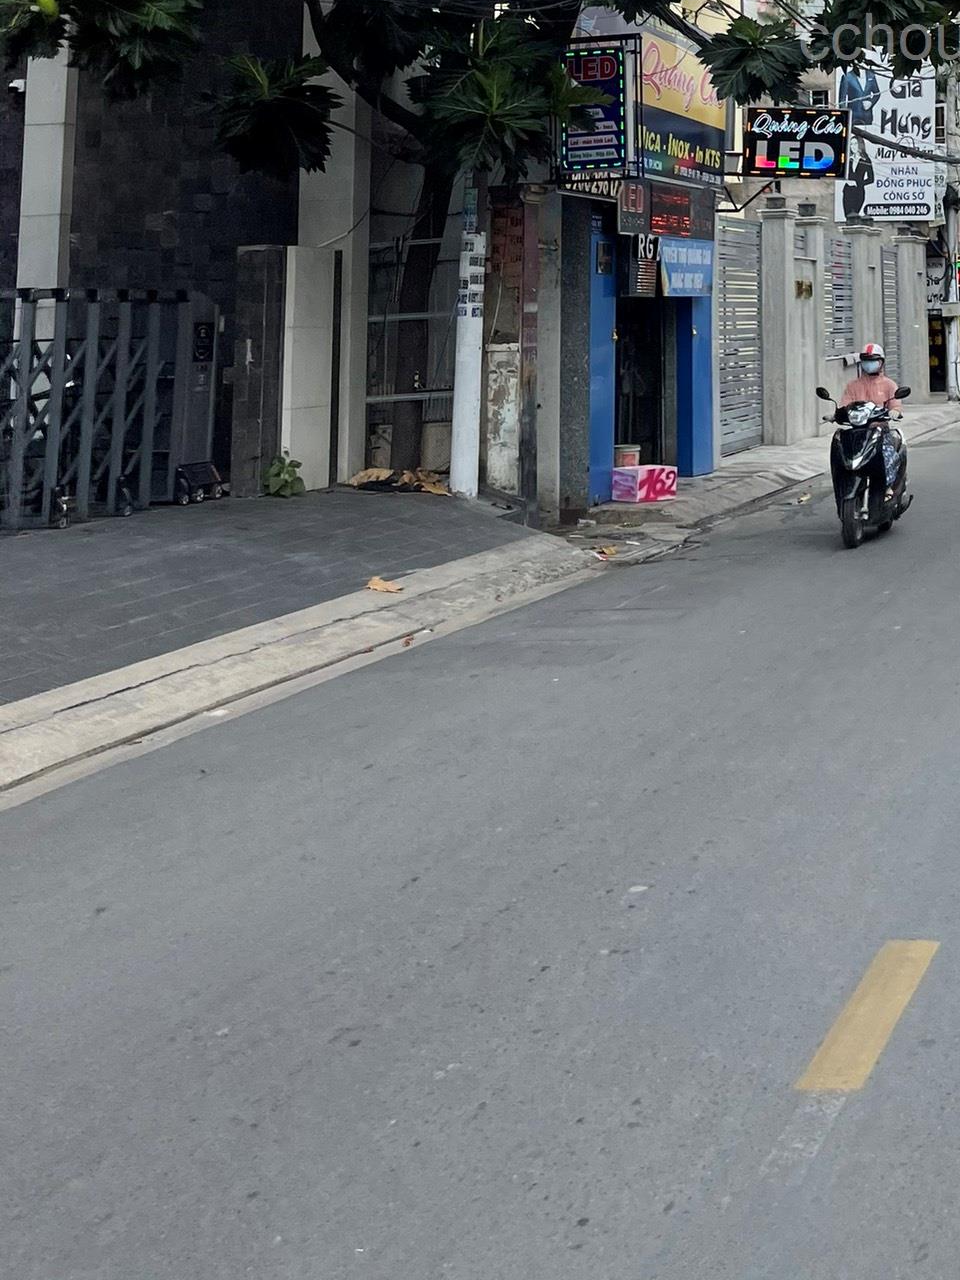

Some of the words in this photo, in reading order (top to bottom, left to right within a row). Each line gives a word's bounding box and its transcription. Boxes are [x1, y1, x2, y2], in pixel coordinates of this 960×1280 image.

[566, 55, 618, 82] LED
[751, 113, 810, 140] Quảng
[812, 114, 844, 135] Cáo
[667, 133, 691, 160] INOX
[704, 148, 722, 169] KTS
[755, 140, 835, 169] LED
[883, 190, 910, 201] CÔNG
[866, 205, 889, 215] Mobile:
[889, 205, 904, 215] 0984
[904, 205, 916, 215] 040
[916, 205, 929, 215] 246
